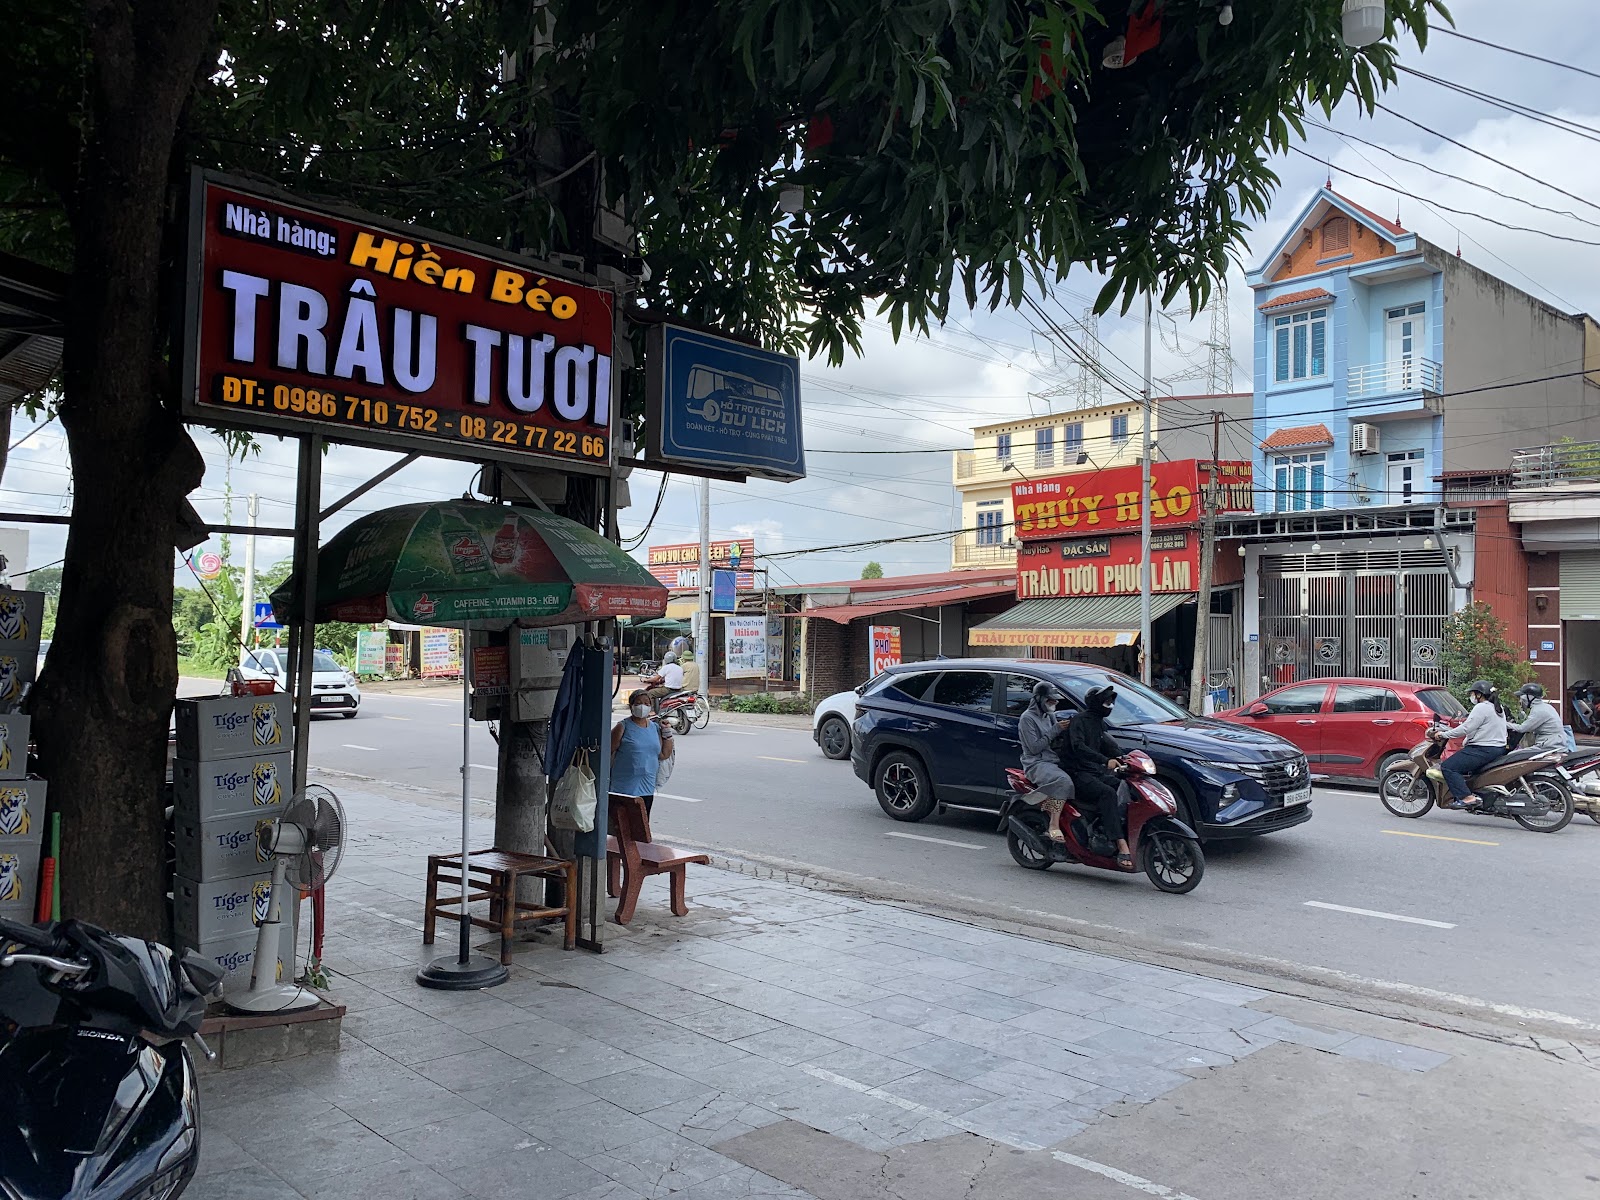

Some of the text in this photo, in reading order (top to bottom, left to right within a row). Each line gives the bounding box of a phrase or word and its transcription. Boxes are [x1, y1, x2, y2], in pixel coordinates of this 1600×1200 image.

[226, 203, 336, 255] Nhà hàng:
[350, 232, 577, 320] Hiền Béo
[223, 270, 611, 426] TRÂU TƯƠI
[223, 376, 265, 407] ĐT:
[274, 385, 337, 417] 0986
[345, 397, 389, 425] 710
[396, 405, 438, 432] 752
[460, 415, 486, 439] 08
[492, 421, 518, 445] 22
[524, 426, 548, 448] 77
[553, 431, 577, 454] 22
[581, 435, 604, 457] 66
[721, 411, 747, 428] DU
[1015, 481, 1061, 496] Nhà Hàng
[1063, 541, 1107, 557] ĐẶC SẢN
[1020, 564, 1060, 597] TRÂU
[1063, 563, 1099, 594] TƯƠI
[1150, 556, 1191, 591] LÂM
[454, 598, 489, 608] CAFFEINE
[495, 596, 526, 606] VITAMIN
[527, 596, 537, 605] B3
[734, 628, 759, 637] Milion
[975, 631, 1006, 644] TRÂU
[1009, 632, 1040, 644] TƯƠI
[1043, 631, 1079, 645] THỦY
[213, 712, 250, 730] Tiger
[213, 772, 250, 790] Tiger
[216, 830, 253, 849] Tiger
[213, 892, 250, 911] Tiger
[214, 951, 252, 971] Tiger
[77, 1029, 125, 1042] HONDA
